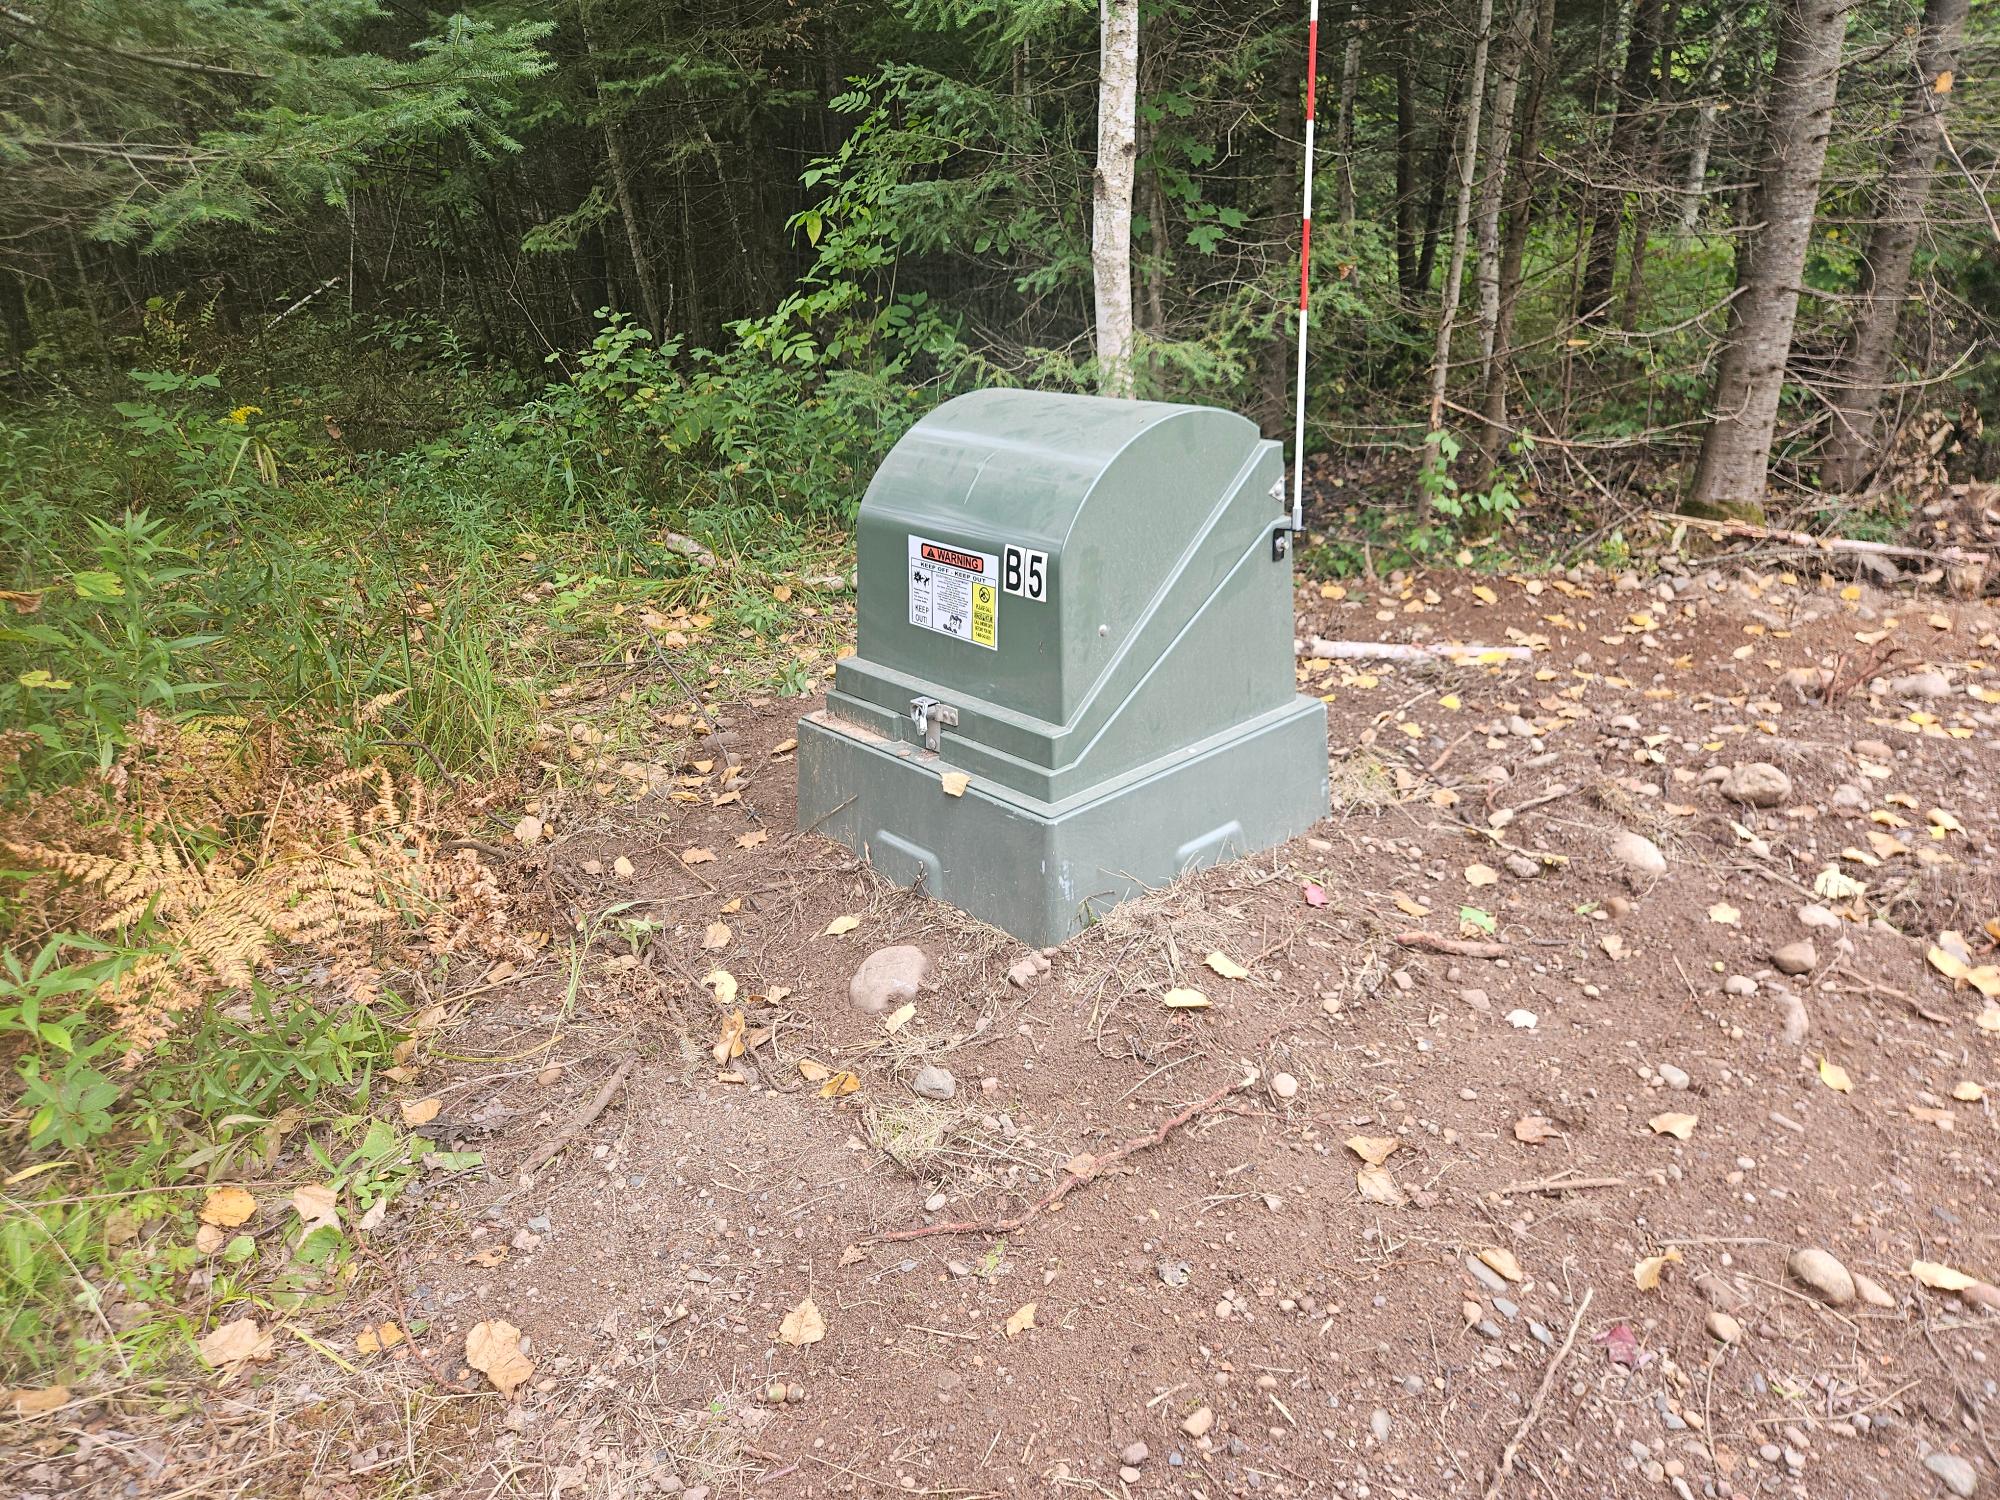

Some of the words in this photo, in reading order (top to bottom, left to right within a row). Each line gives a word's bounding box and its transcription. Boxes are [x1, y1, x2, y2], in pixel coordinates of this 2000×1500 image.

[937, 549, 979, 570] WARNING
[920, 562, 936, 570] KEEP
[937, 566, 949, 574] OFF
[954, 570, 971, 580] KEEP
[972, 576, 986, 584] OUT
[1005, 547, 1043, 598] B5
[915, 604, 929, 614] KEEP
